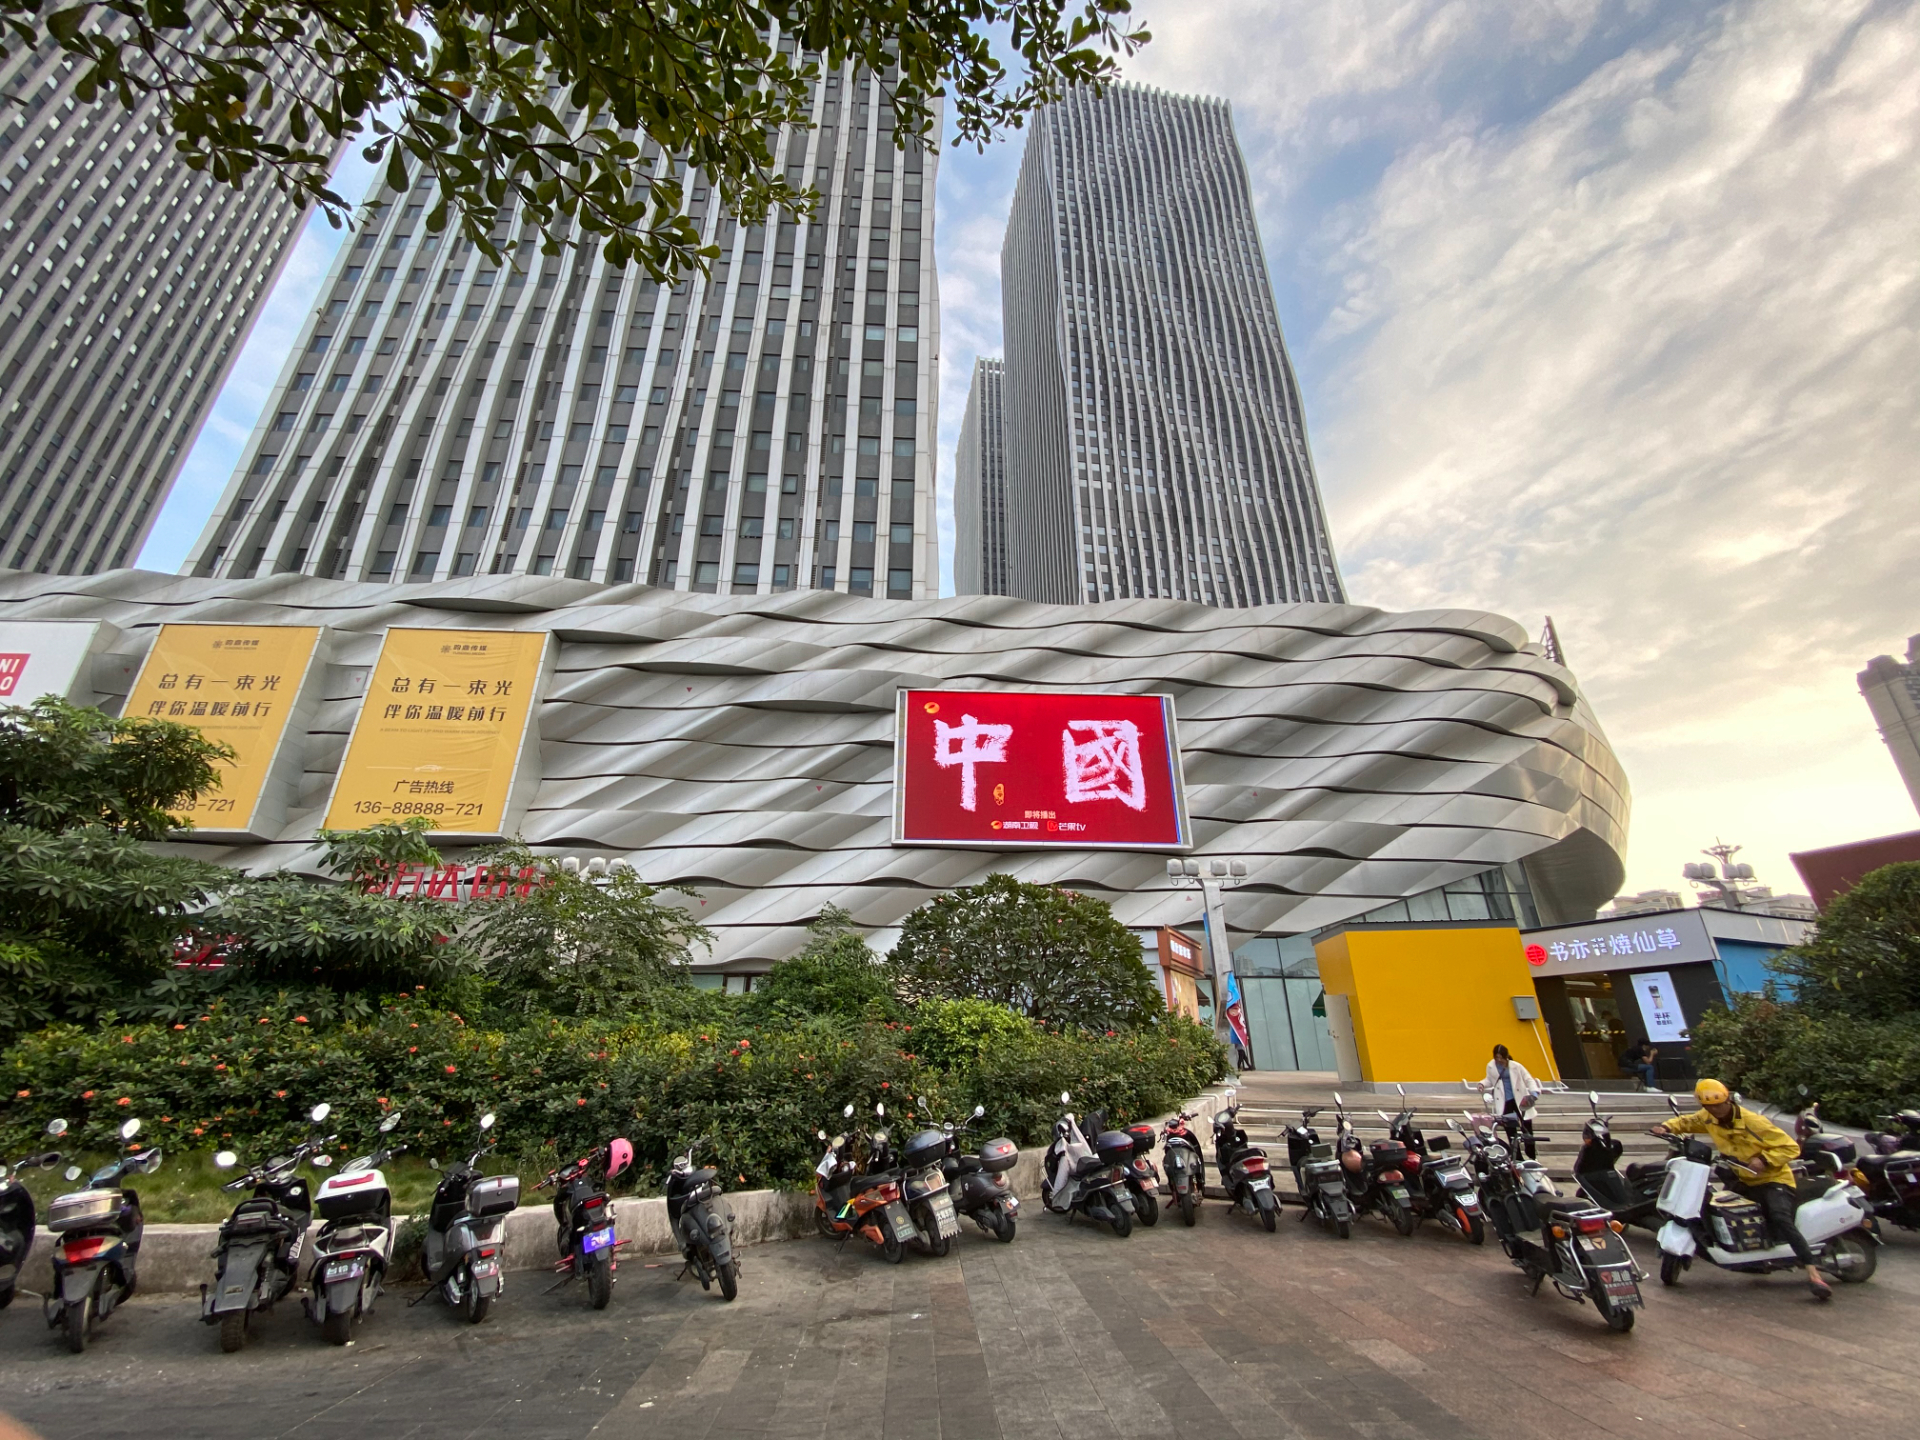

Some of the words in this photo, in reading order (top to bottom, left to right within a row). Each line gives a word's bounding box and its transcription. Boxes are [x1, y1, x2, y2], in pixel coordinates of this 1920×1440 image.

[158, 673, 282, 691] 总有一束光
[391, 677, 514, 696] 总有一束光
[148, 700, 273, 717] 伴你温暖前行
[383, 703, 507, 722] 伴你温暖前行
[393, 780, 455, 795] 广告热线
[353, 800, 483, 816] 136-88888-721
